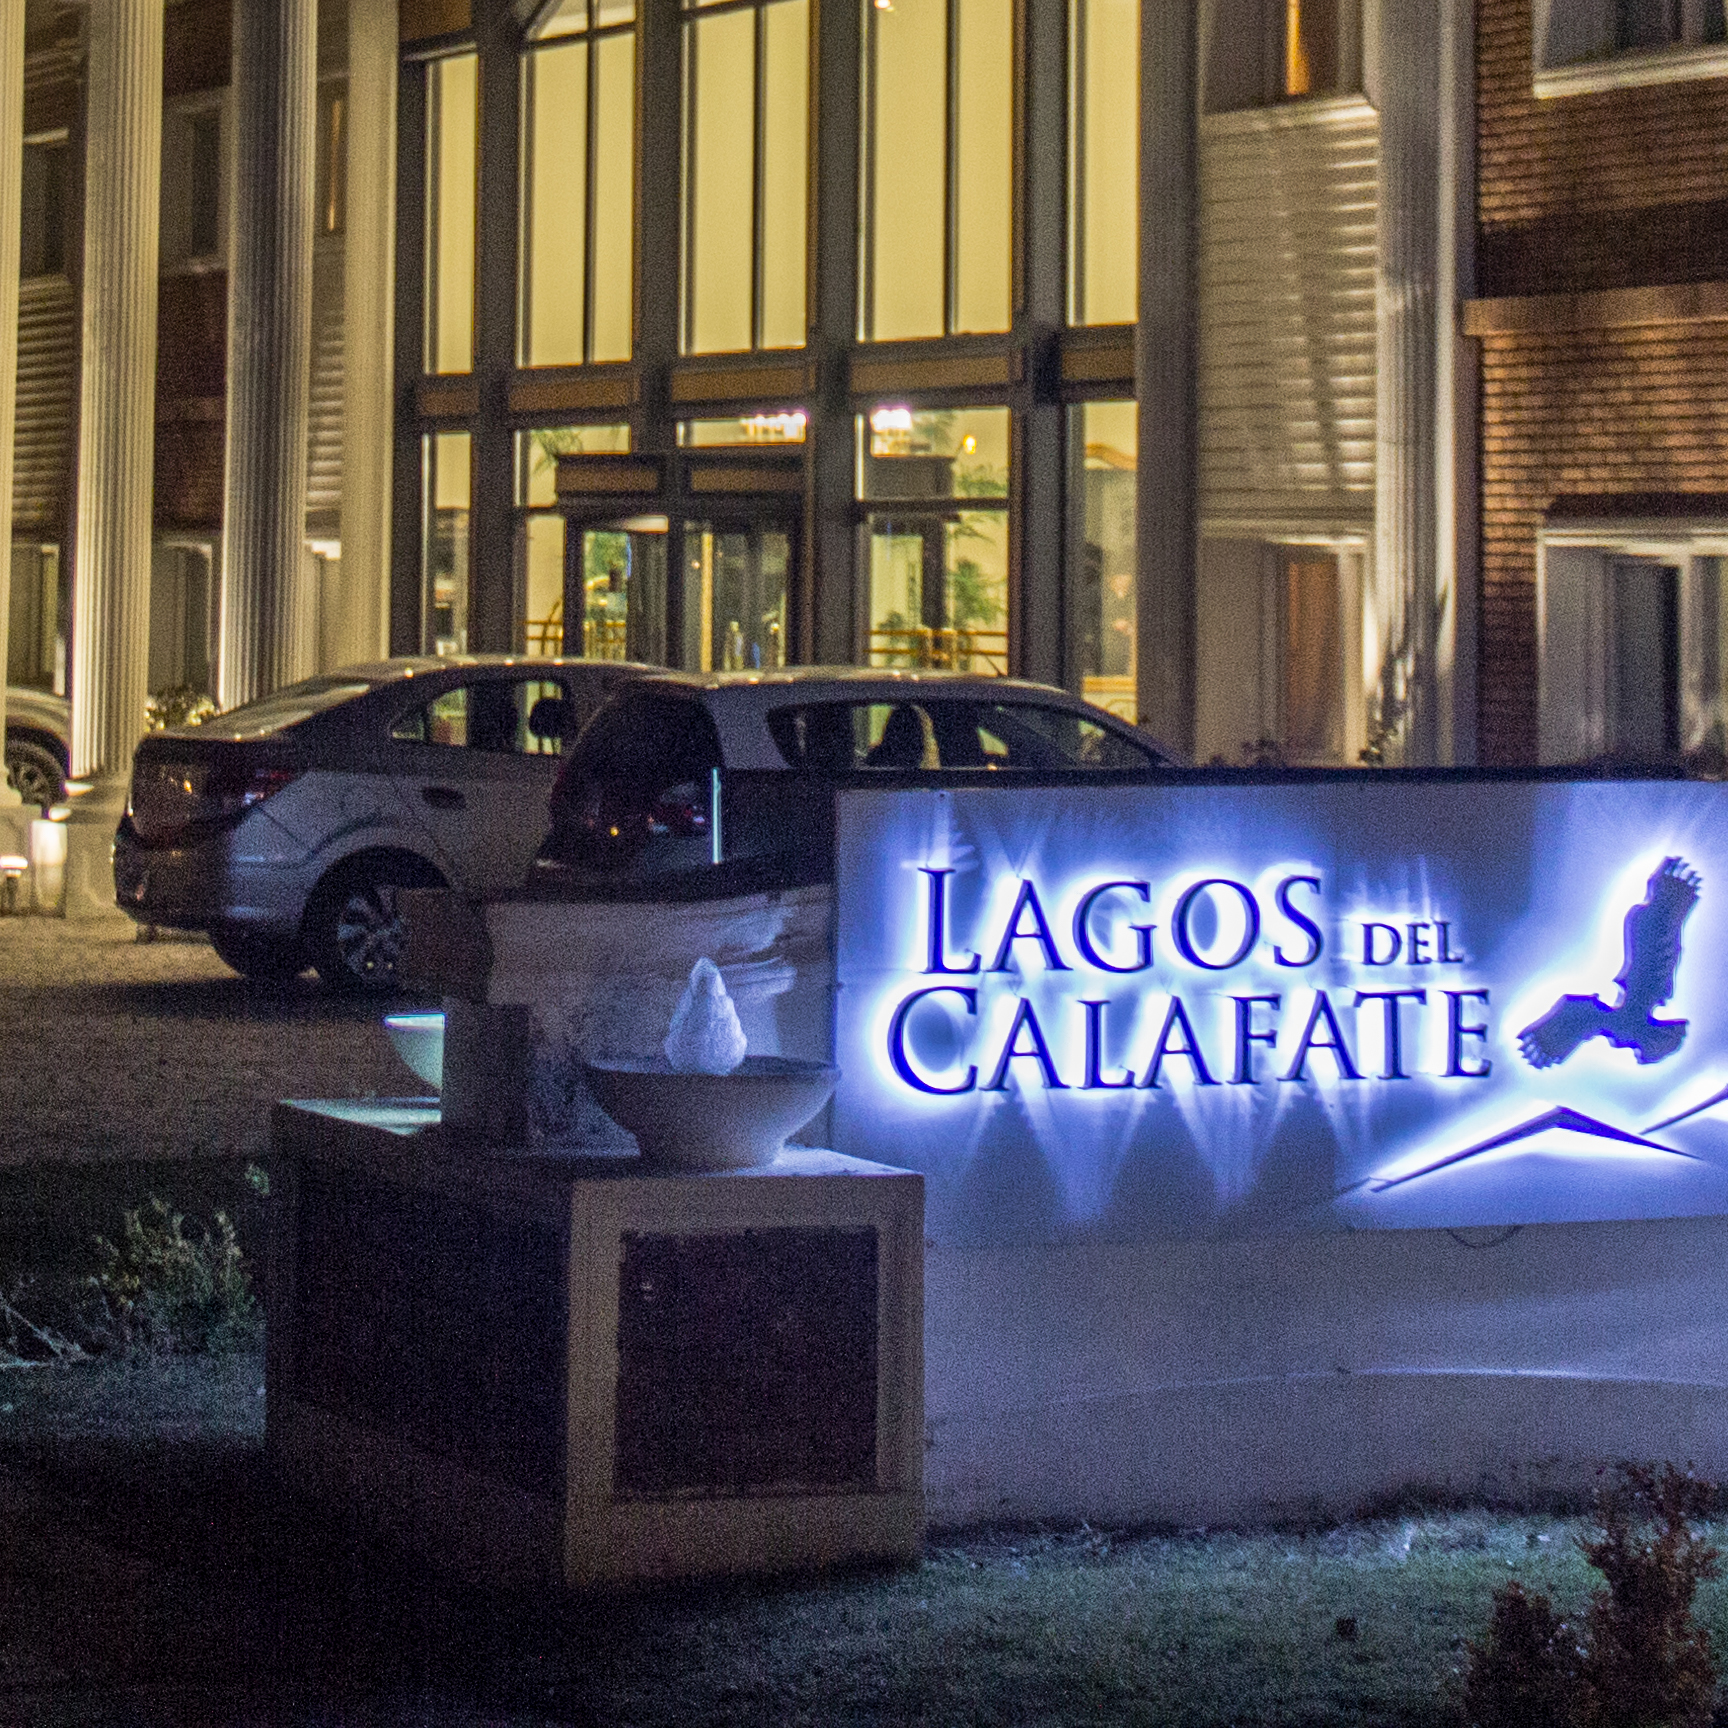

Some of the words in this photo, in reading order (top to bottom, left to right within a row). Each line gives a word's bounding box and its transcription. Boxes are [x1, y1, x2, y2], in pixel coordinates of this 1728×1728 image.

[918, 867, 1323, 975] LAGOS
[1363, 920, 1464, 967] DEL
[887, 985, 1493, 1095] CALAFATE
